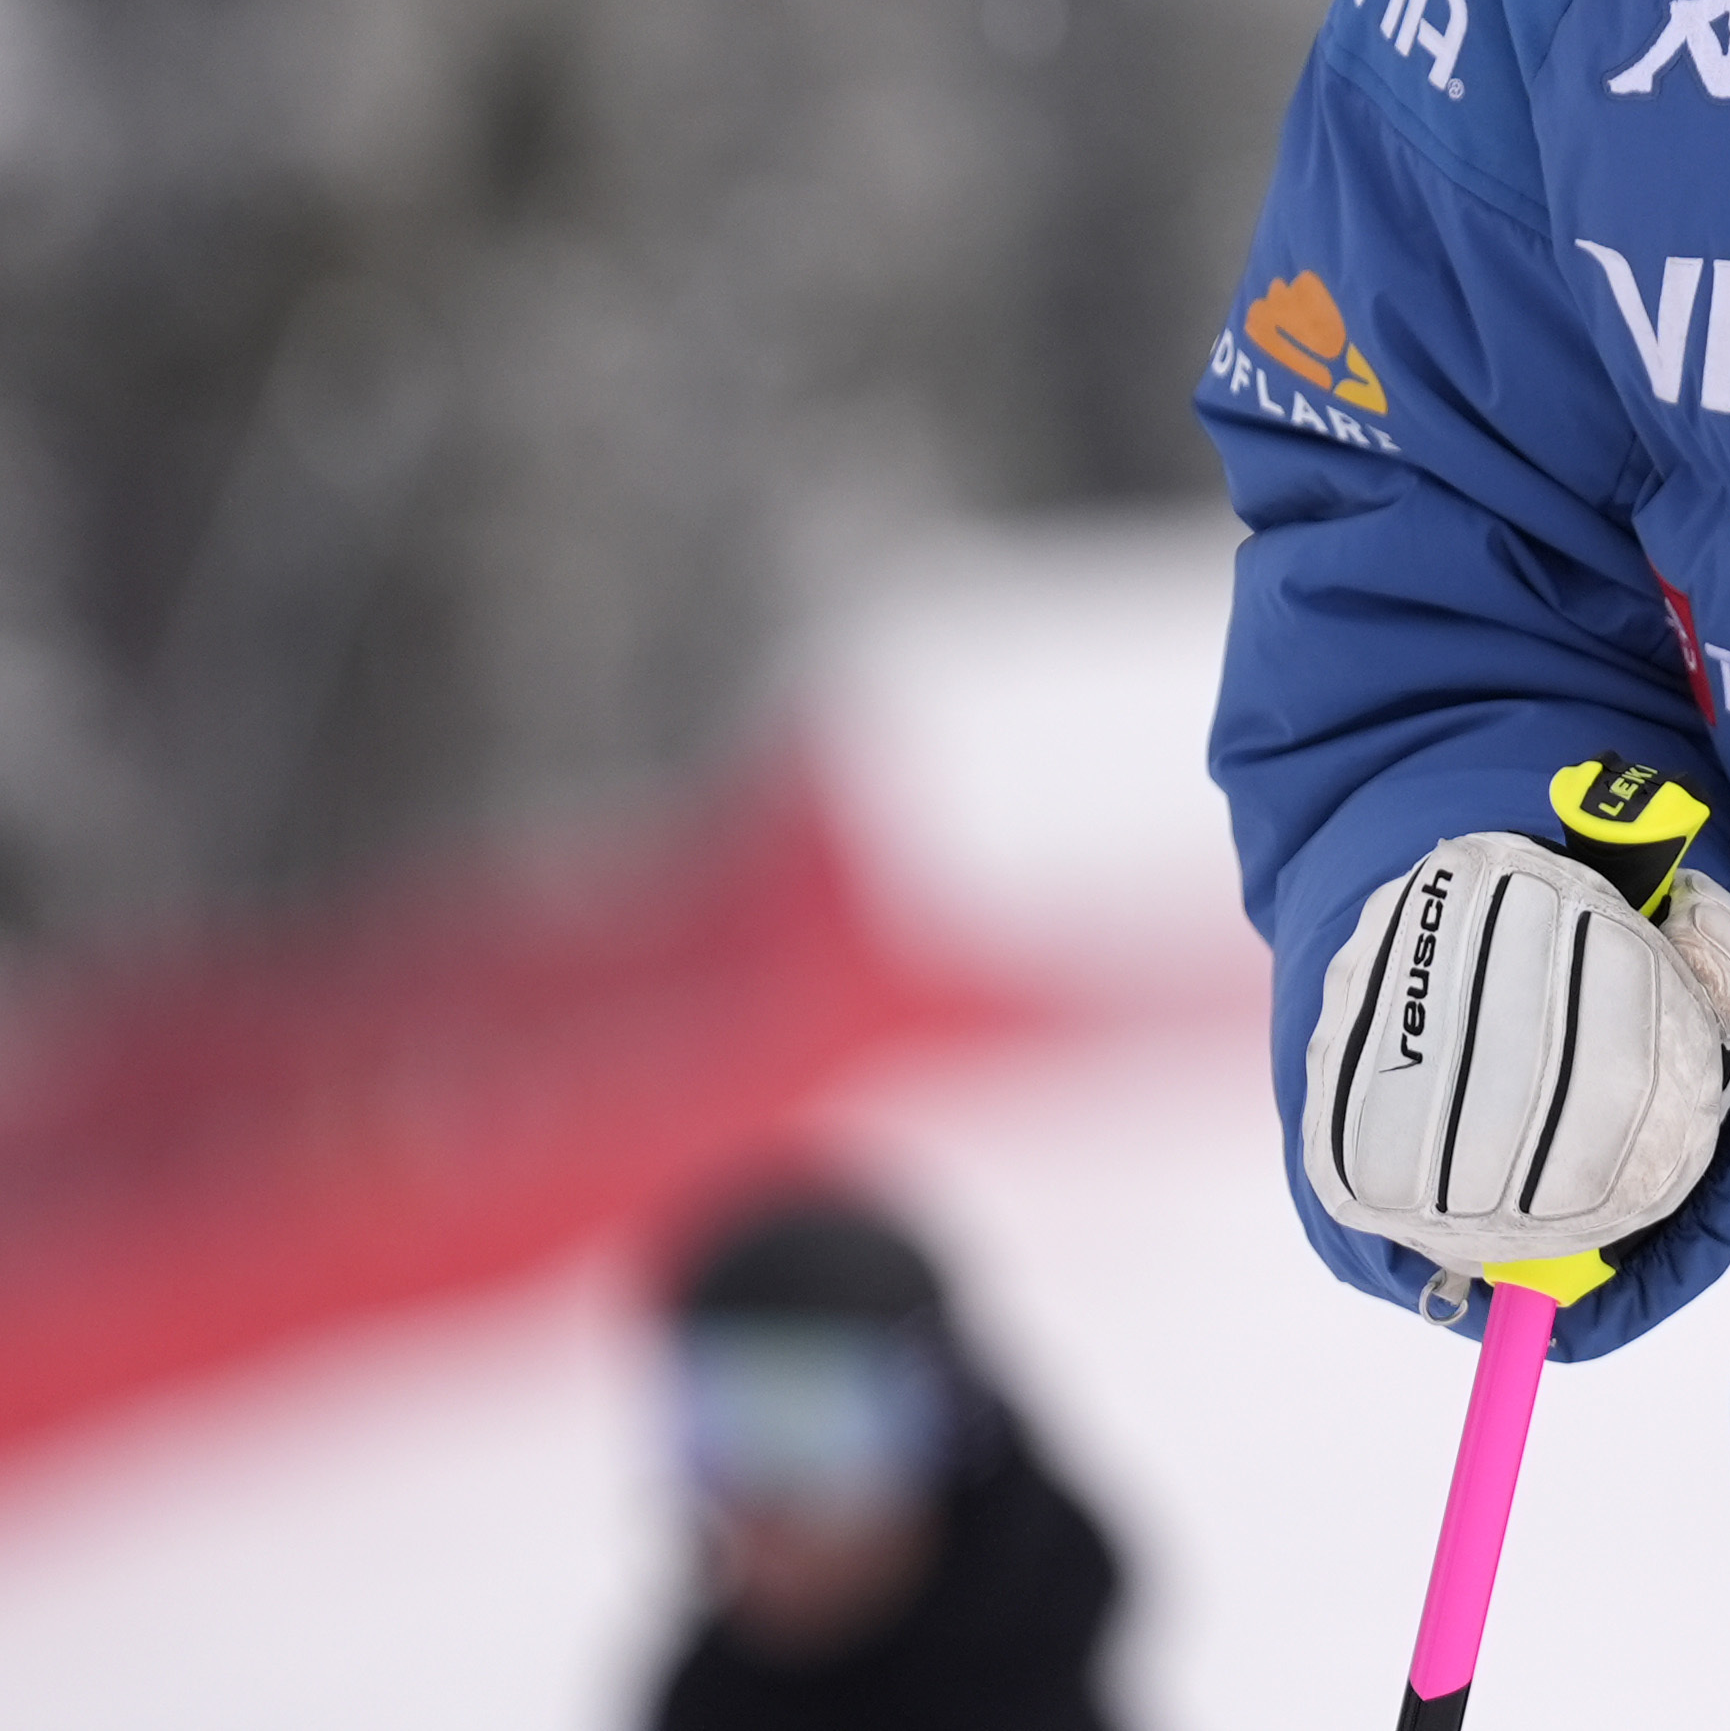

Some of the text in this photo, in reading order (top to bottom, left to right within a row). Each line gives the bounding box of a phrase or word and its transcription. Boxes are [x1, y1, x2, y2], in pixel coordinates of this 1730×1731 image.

[1211, 327, 1401, 453] DFLARE
[1598, 764, 1658, 817] LEKI
[1388, 868, 1454, 1070] reusch
